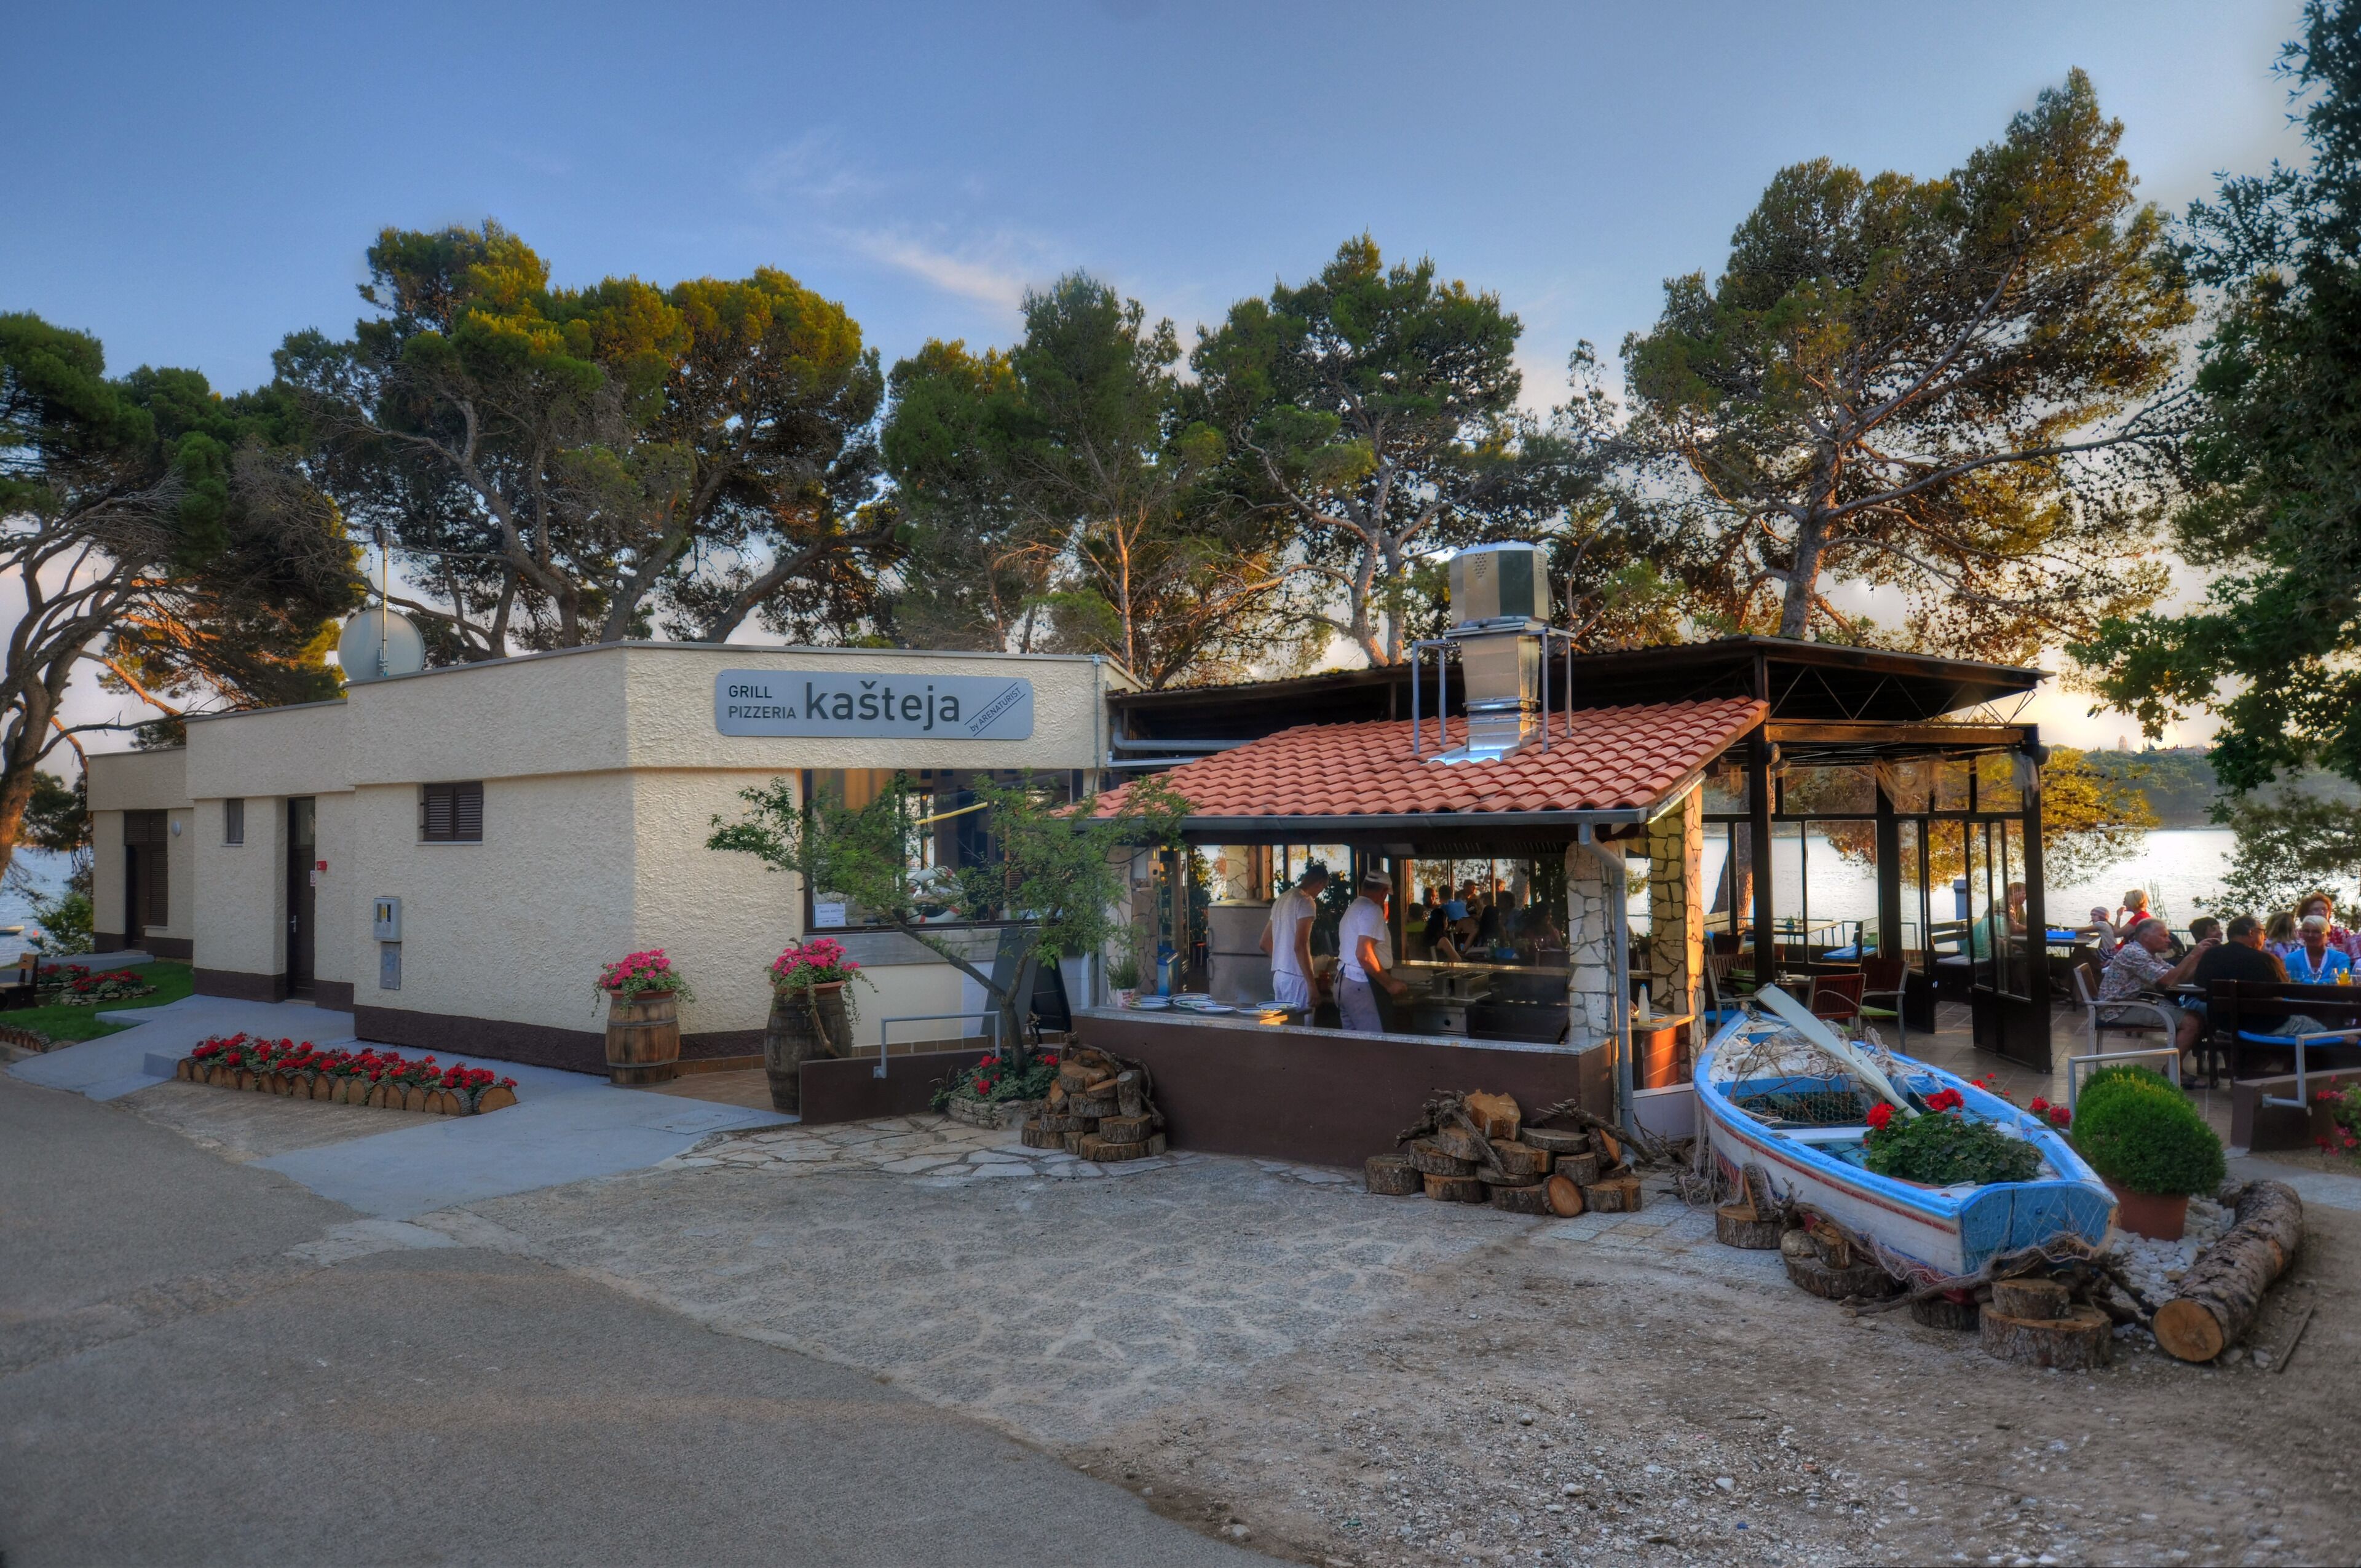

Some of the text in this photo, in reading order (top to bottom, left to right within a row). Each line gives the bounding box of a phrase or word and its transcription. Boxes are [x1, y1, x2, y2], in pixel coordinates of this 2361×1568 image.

[729, 685, 773, 698] GRILL
[806, 680, 959, 731] kašteja
[729, 705, 797, 719] PIZZERIA
[969, 687, 1021, 732] by ARENATURIST
